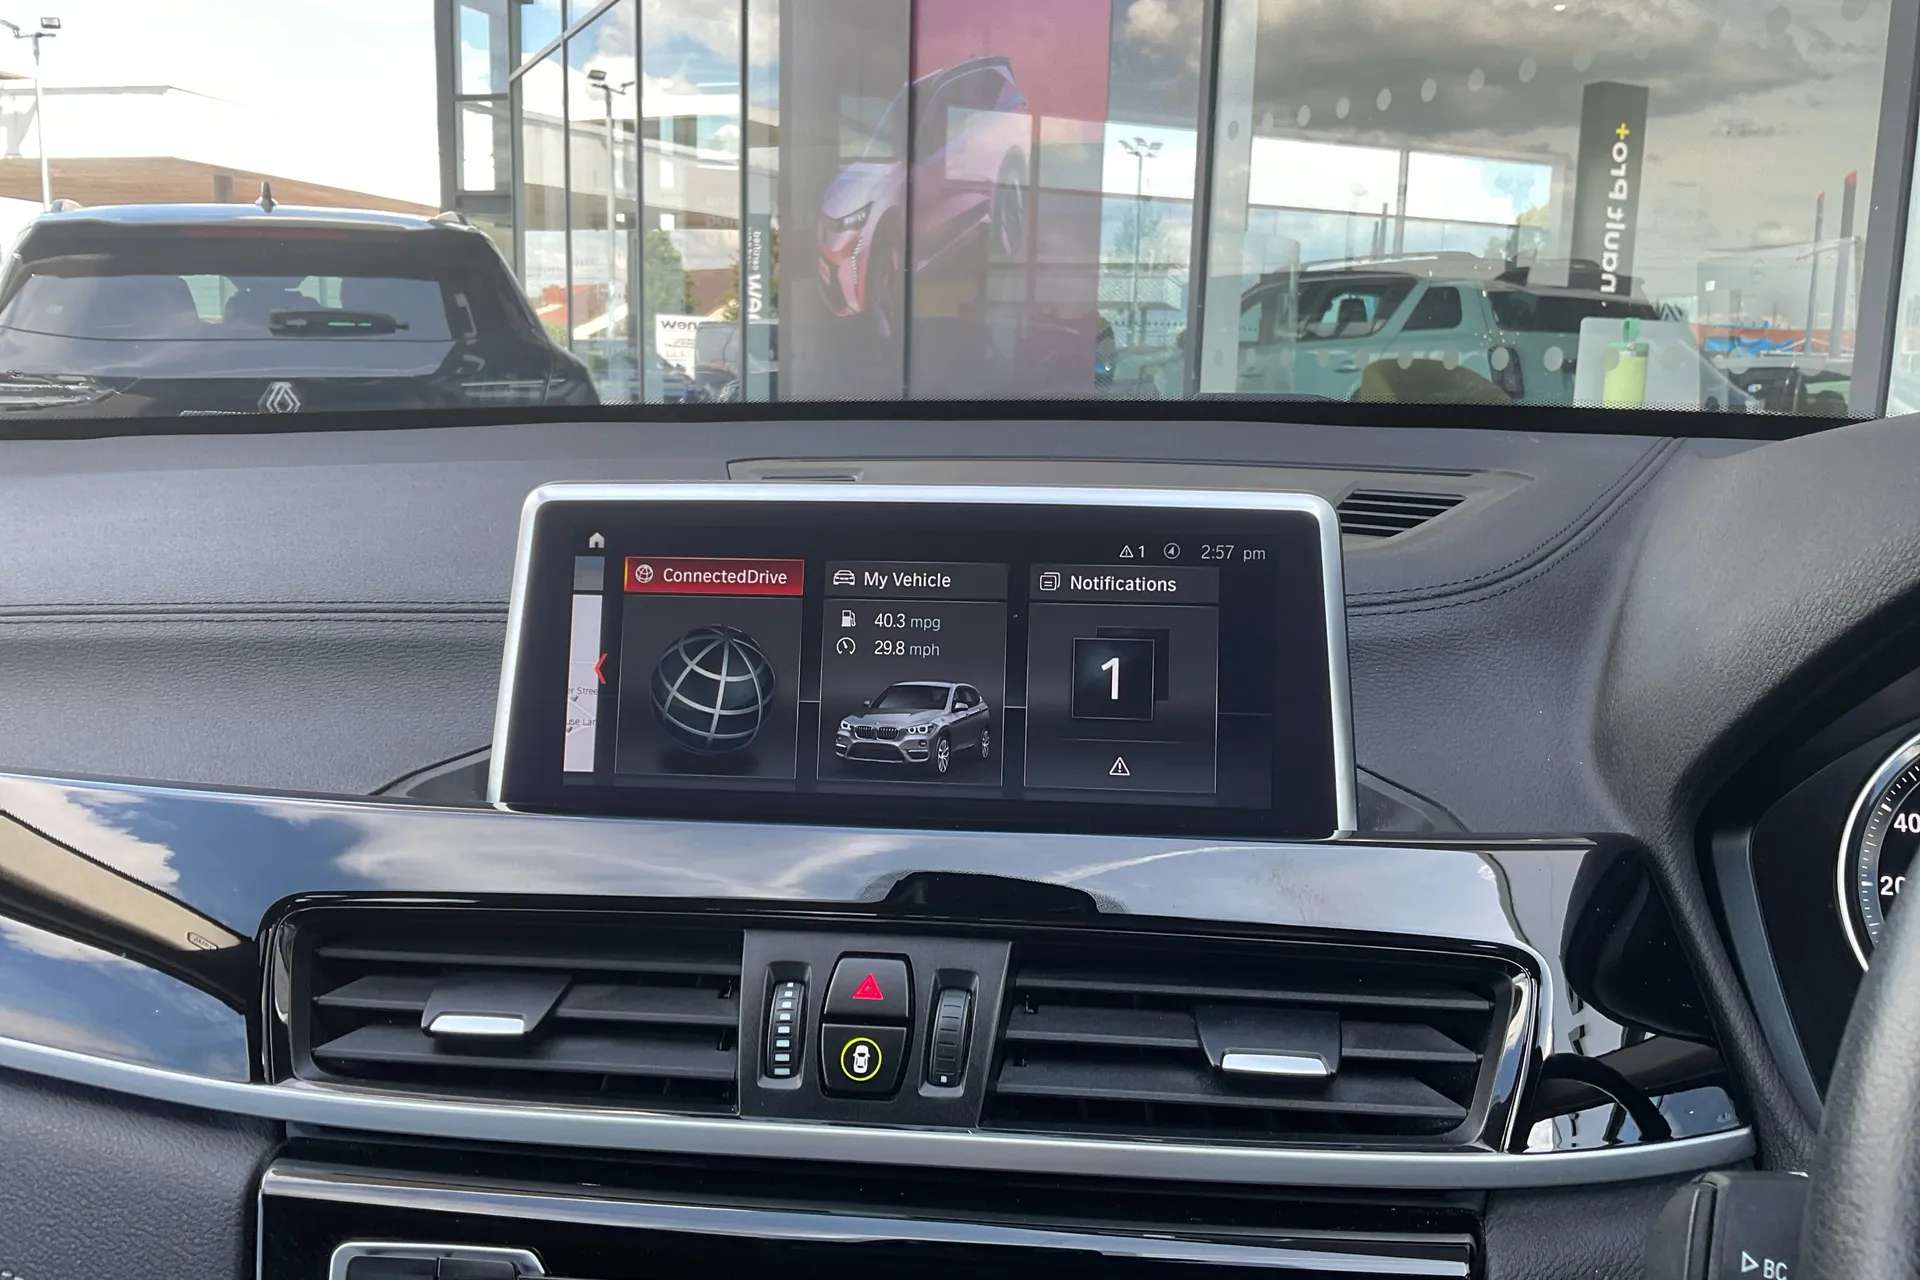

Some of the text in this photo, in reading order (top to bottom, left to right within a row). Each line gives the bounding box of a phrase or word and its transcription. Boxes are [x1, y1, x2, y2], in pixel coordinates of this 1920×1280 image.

[1138, 545, 1145, 558] 1
[1201, 544, 1266, 562] 2:57 pm
[663, 568, 788, 585] ConnectedDrive
[864, 571, 952, 590] My Vehicle
[1070, 575, 1177, 592] Notifications
[874, 613, 941, 632] 40.3 mpg
[874, 640, 940, 659] 29.8 mph
[1101, 657, 1120, 700] 1
[1893, 812, 1920, 834] 40
[1763, 1258, 1788, 1280] BC
